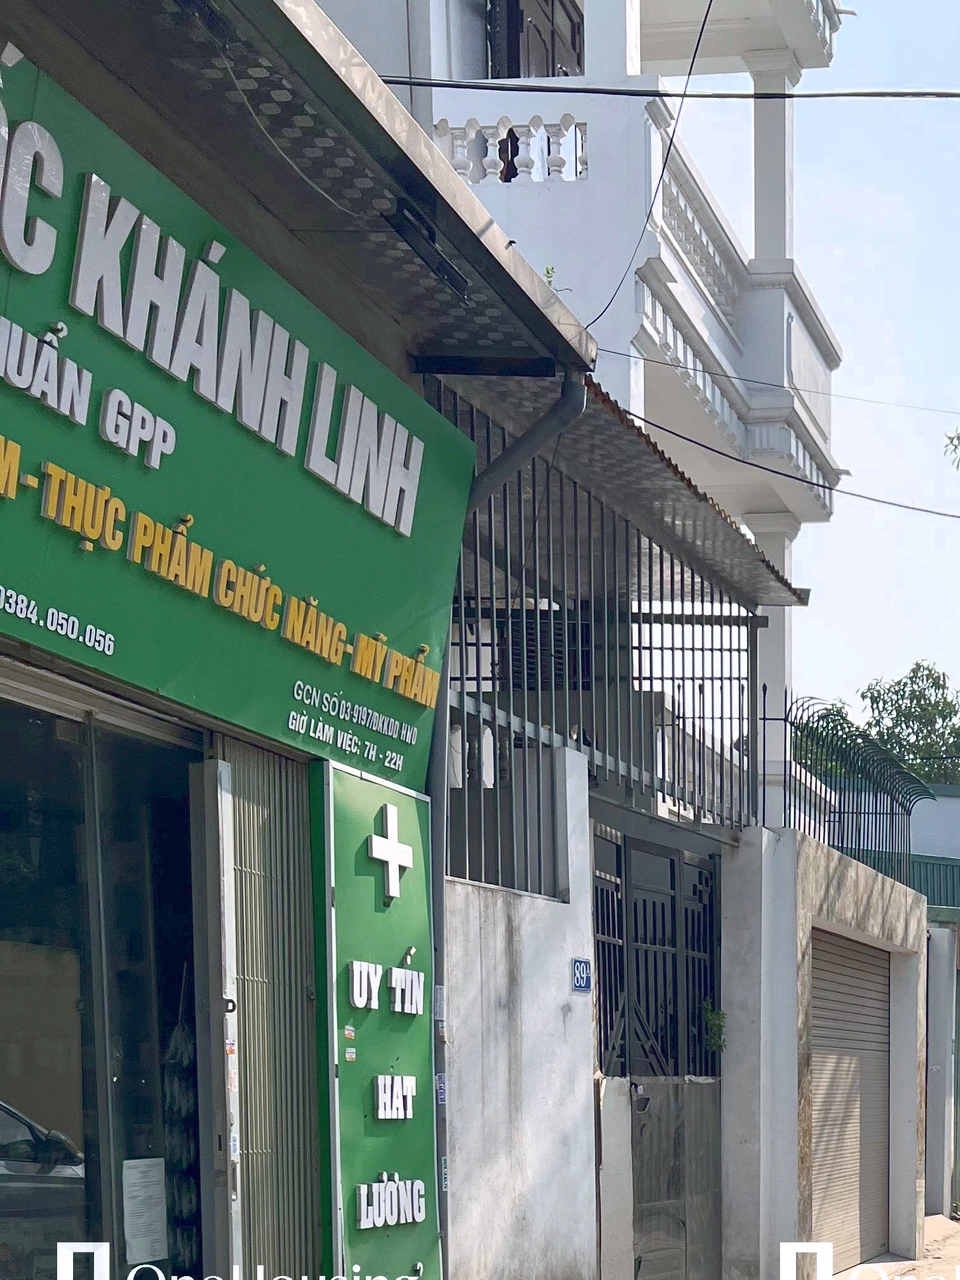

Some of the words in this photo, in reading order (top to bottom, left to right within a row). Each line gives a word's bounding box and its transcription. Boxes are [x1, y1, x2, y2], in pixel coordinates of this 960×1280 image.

[69, 173, 309, 457] KHÁNH
[304, 361, 424, 536] LINH
[100, 389, 176, 470] GPP
[43, 461, 126, 551] THỰC
[127, 514, 213, 598] PHẨM
[213, 559, 282, 631] CHỨC
[383, 644, 440, 709] PHẨM
[294, 680, 320, 708] GCN
[322, 690, 343, 716] SỐ
[289, 710, 308, 734] GIỜ
[309, 717, 334, 744] LÀM
[364, 741, 377, 761] 7H
[384, 750, 404, 772] 22H
[349, 960, 382, 1010] UY
[388, 946, 424, 1015] TÍN
[374, 1075, 416, 1119] HAT
